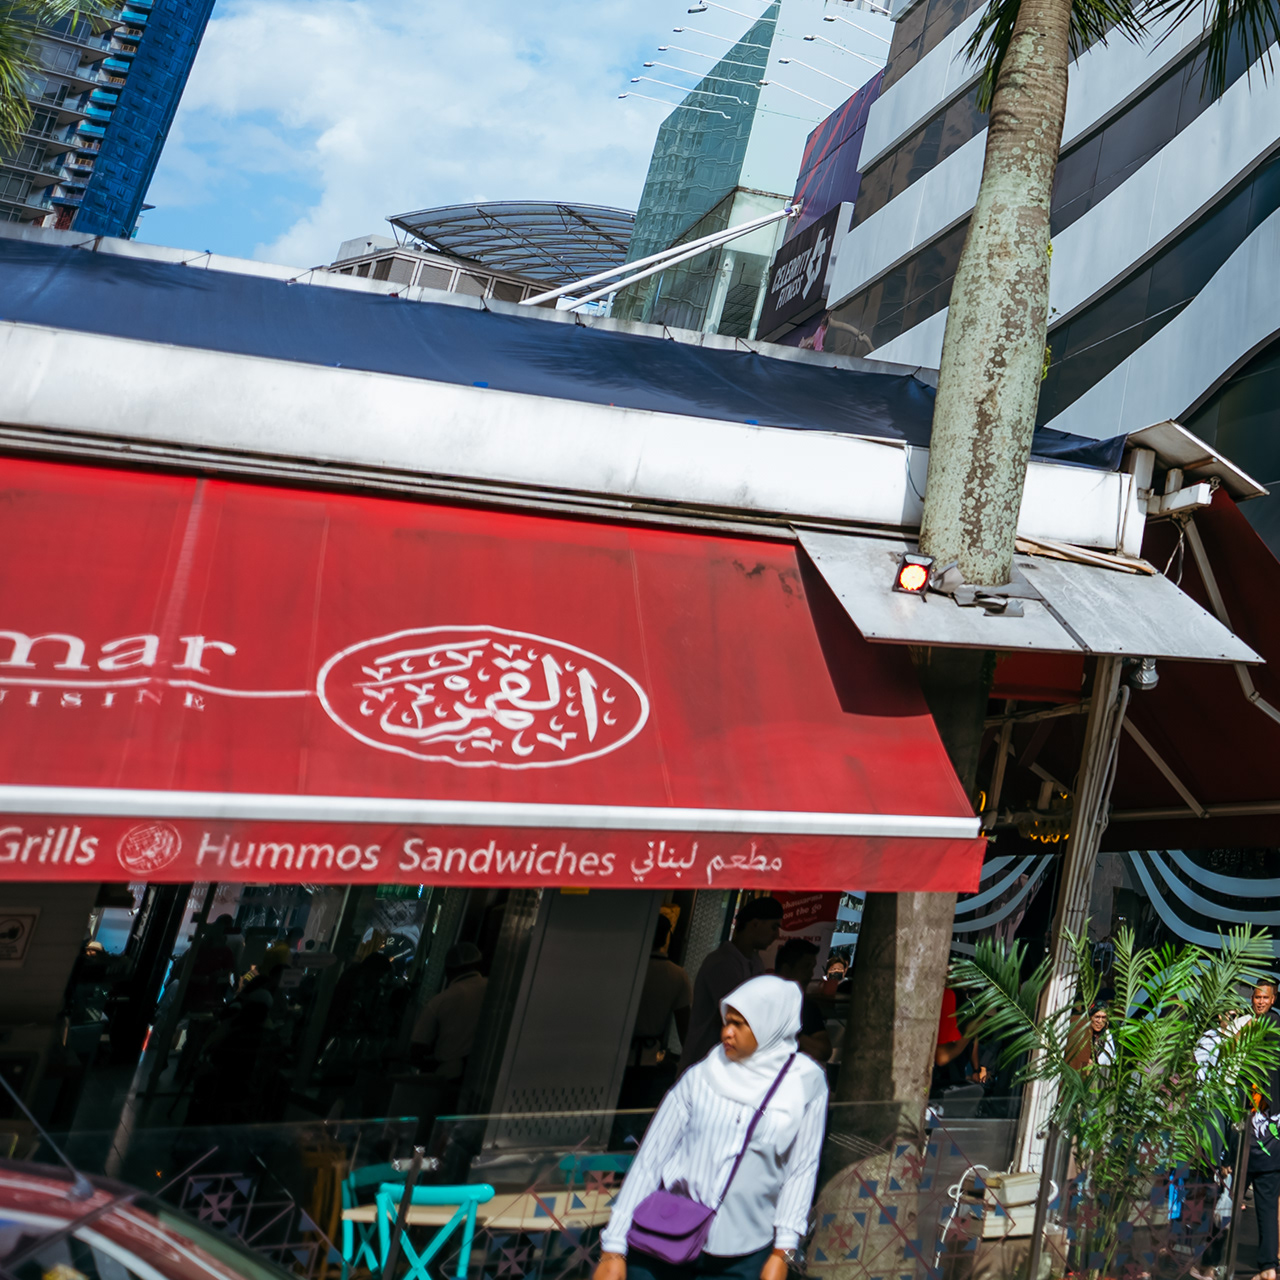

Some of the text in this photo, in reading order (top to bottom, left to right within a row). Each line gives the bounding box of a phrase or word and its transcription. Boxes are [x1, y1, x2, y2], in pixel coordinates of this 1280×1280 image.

[771, 247, 813, 295] CELEBRITY
[775, 273, 805, 312] FITNESS
[0, 687, 205, 712] ISINE
[0, 824, 99, 865] Grills
[196, 832, 380, 871] Hummos
[399, 837, 616, 876] Sandwiches
[630, 839, 783, 885] مطعم لبناني
